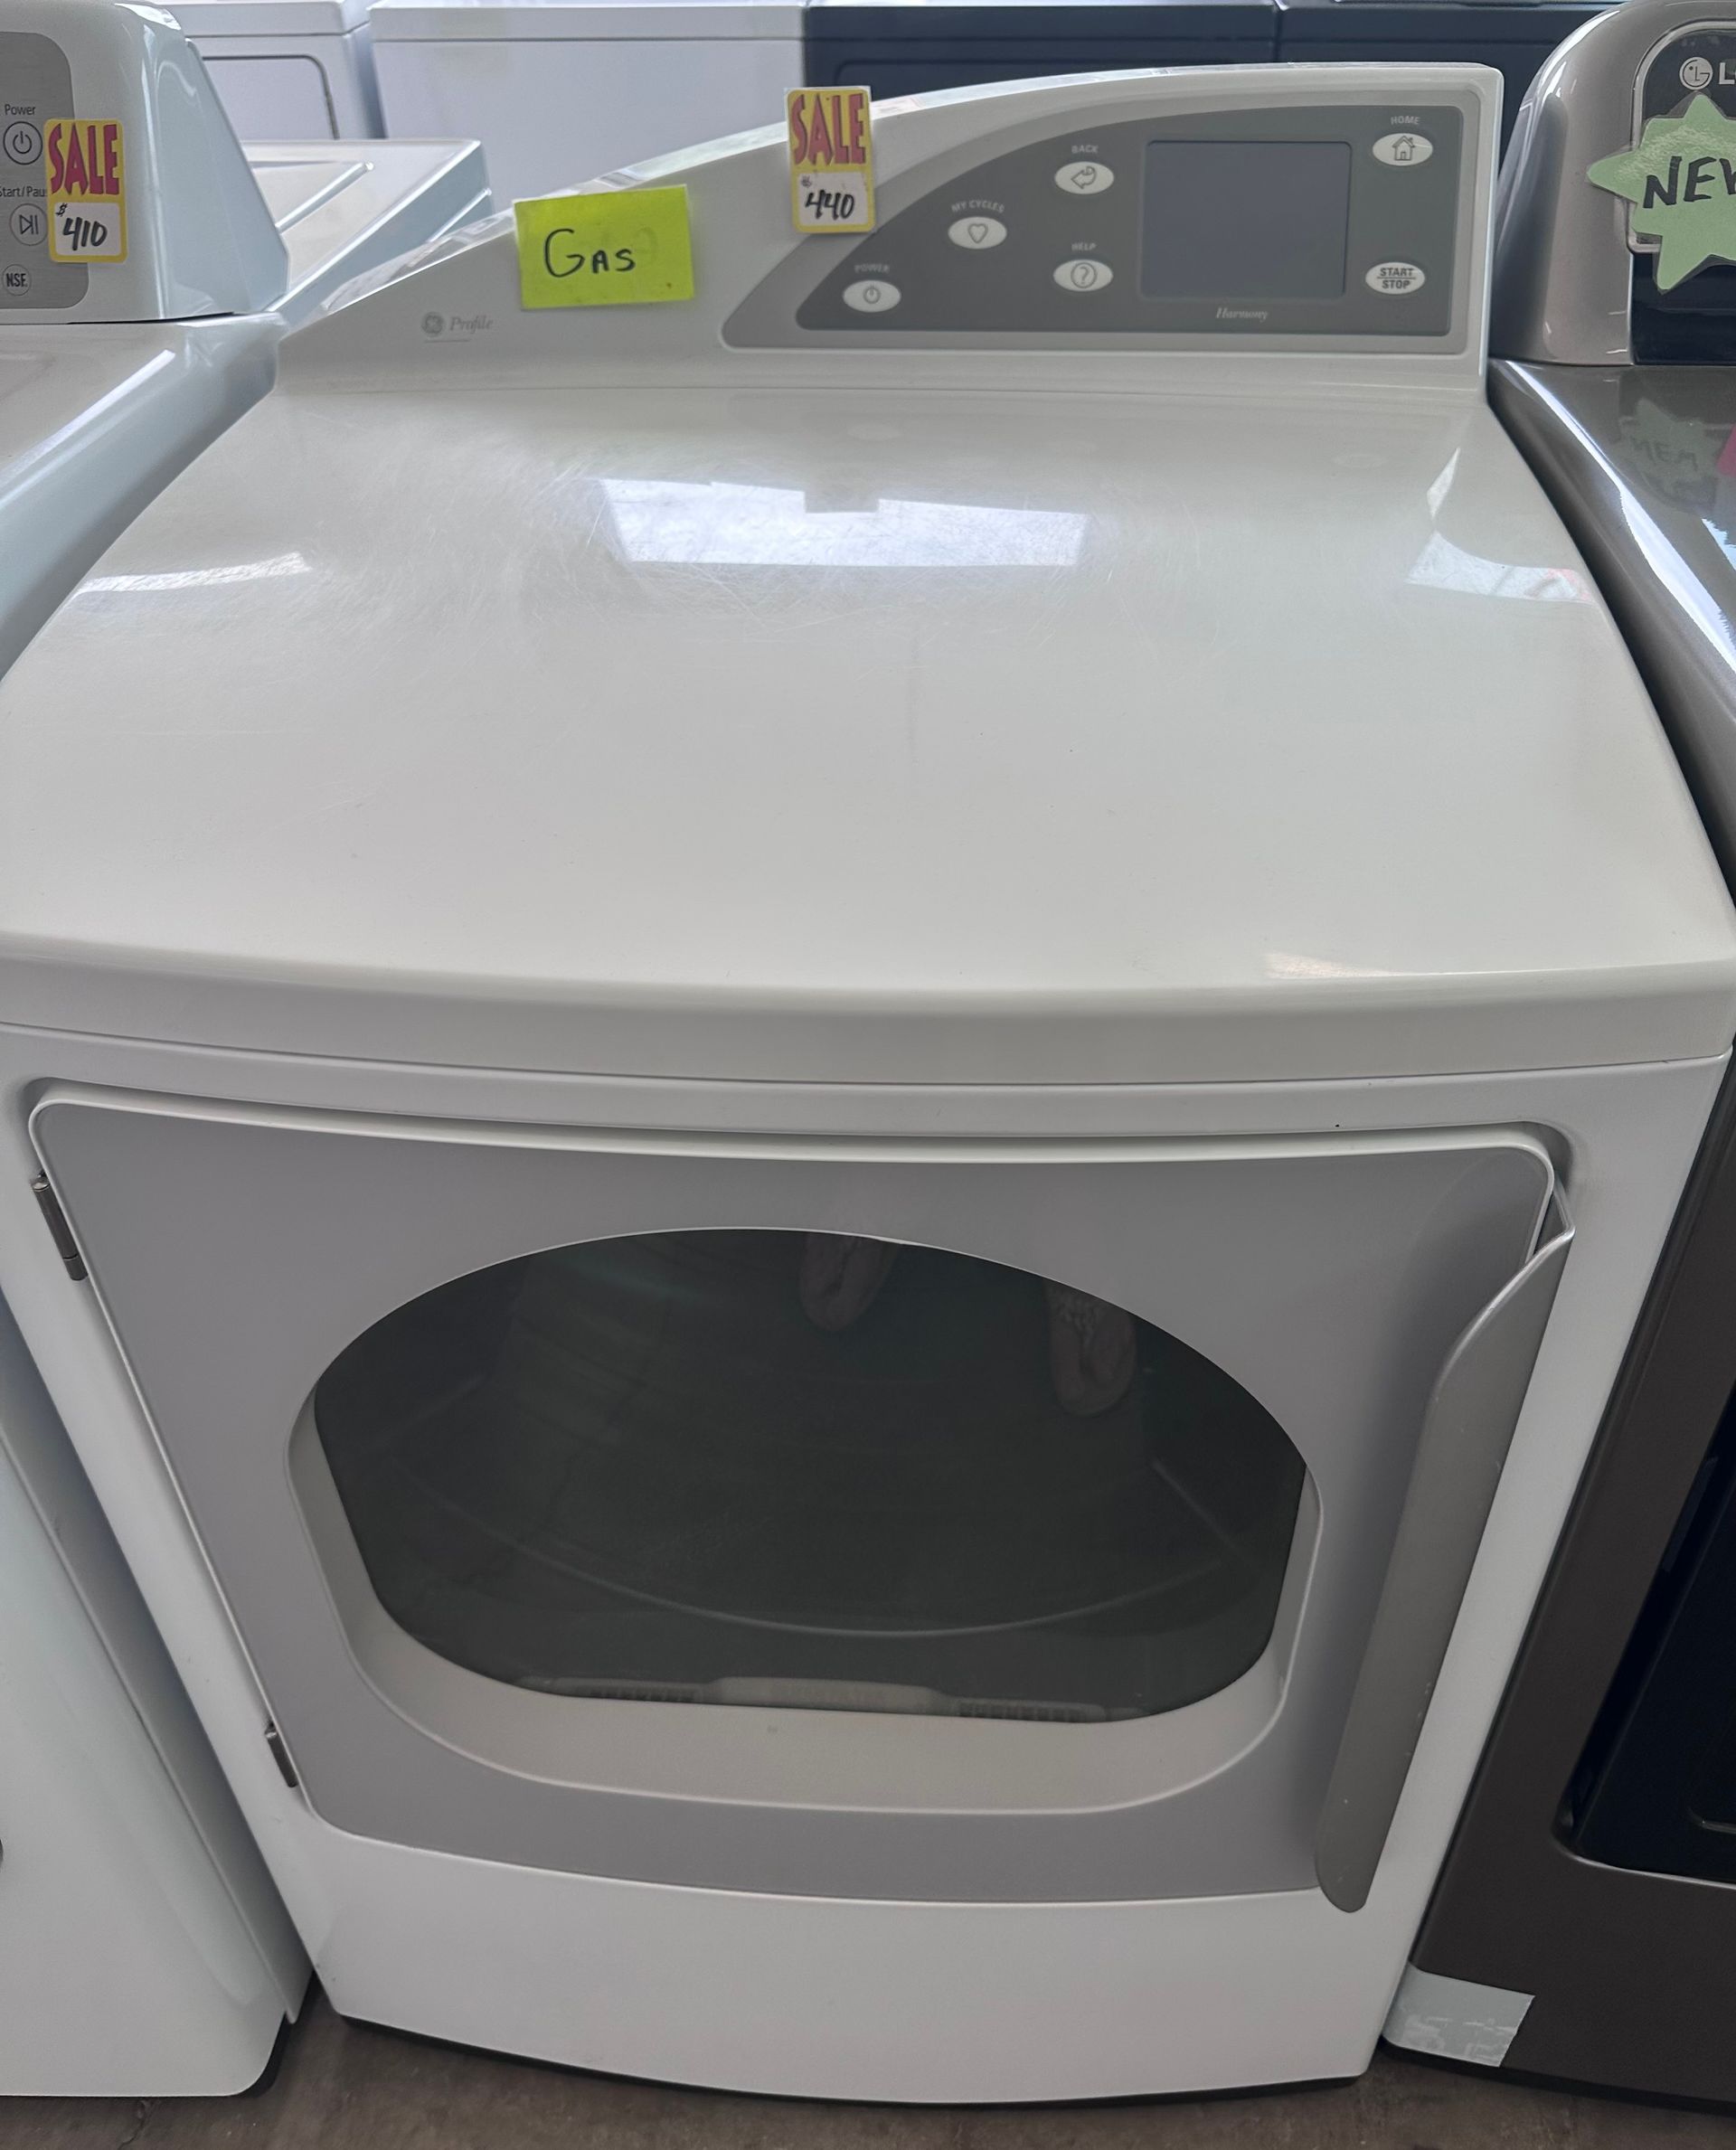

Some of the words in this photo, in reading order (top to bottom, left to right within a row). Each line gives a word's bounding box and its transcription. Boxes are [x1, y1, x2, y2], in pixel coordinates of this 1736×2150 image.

[1719, 61, 1736, 85] L
[5, 103, 36, 116] Power
[1391, 115, 1420, 126] HOME
[791, 93, 865, 165] SALE
[1071, 145, 1099, 154] BACK
[48, 123, 119, 195] SALE
[0, 185, 46, 197] tart/Pau
[1380, 267, 1415, 277] START
[1382, 279, 1410, 289] STOP
